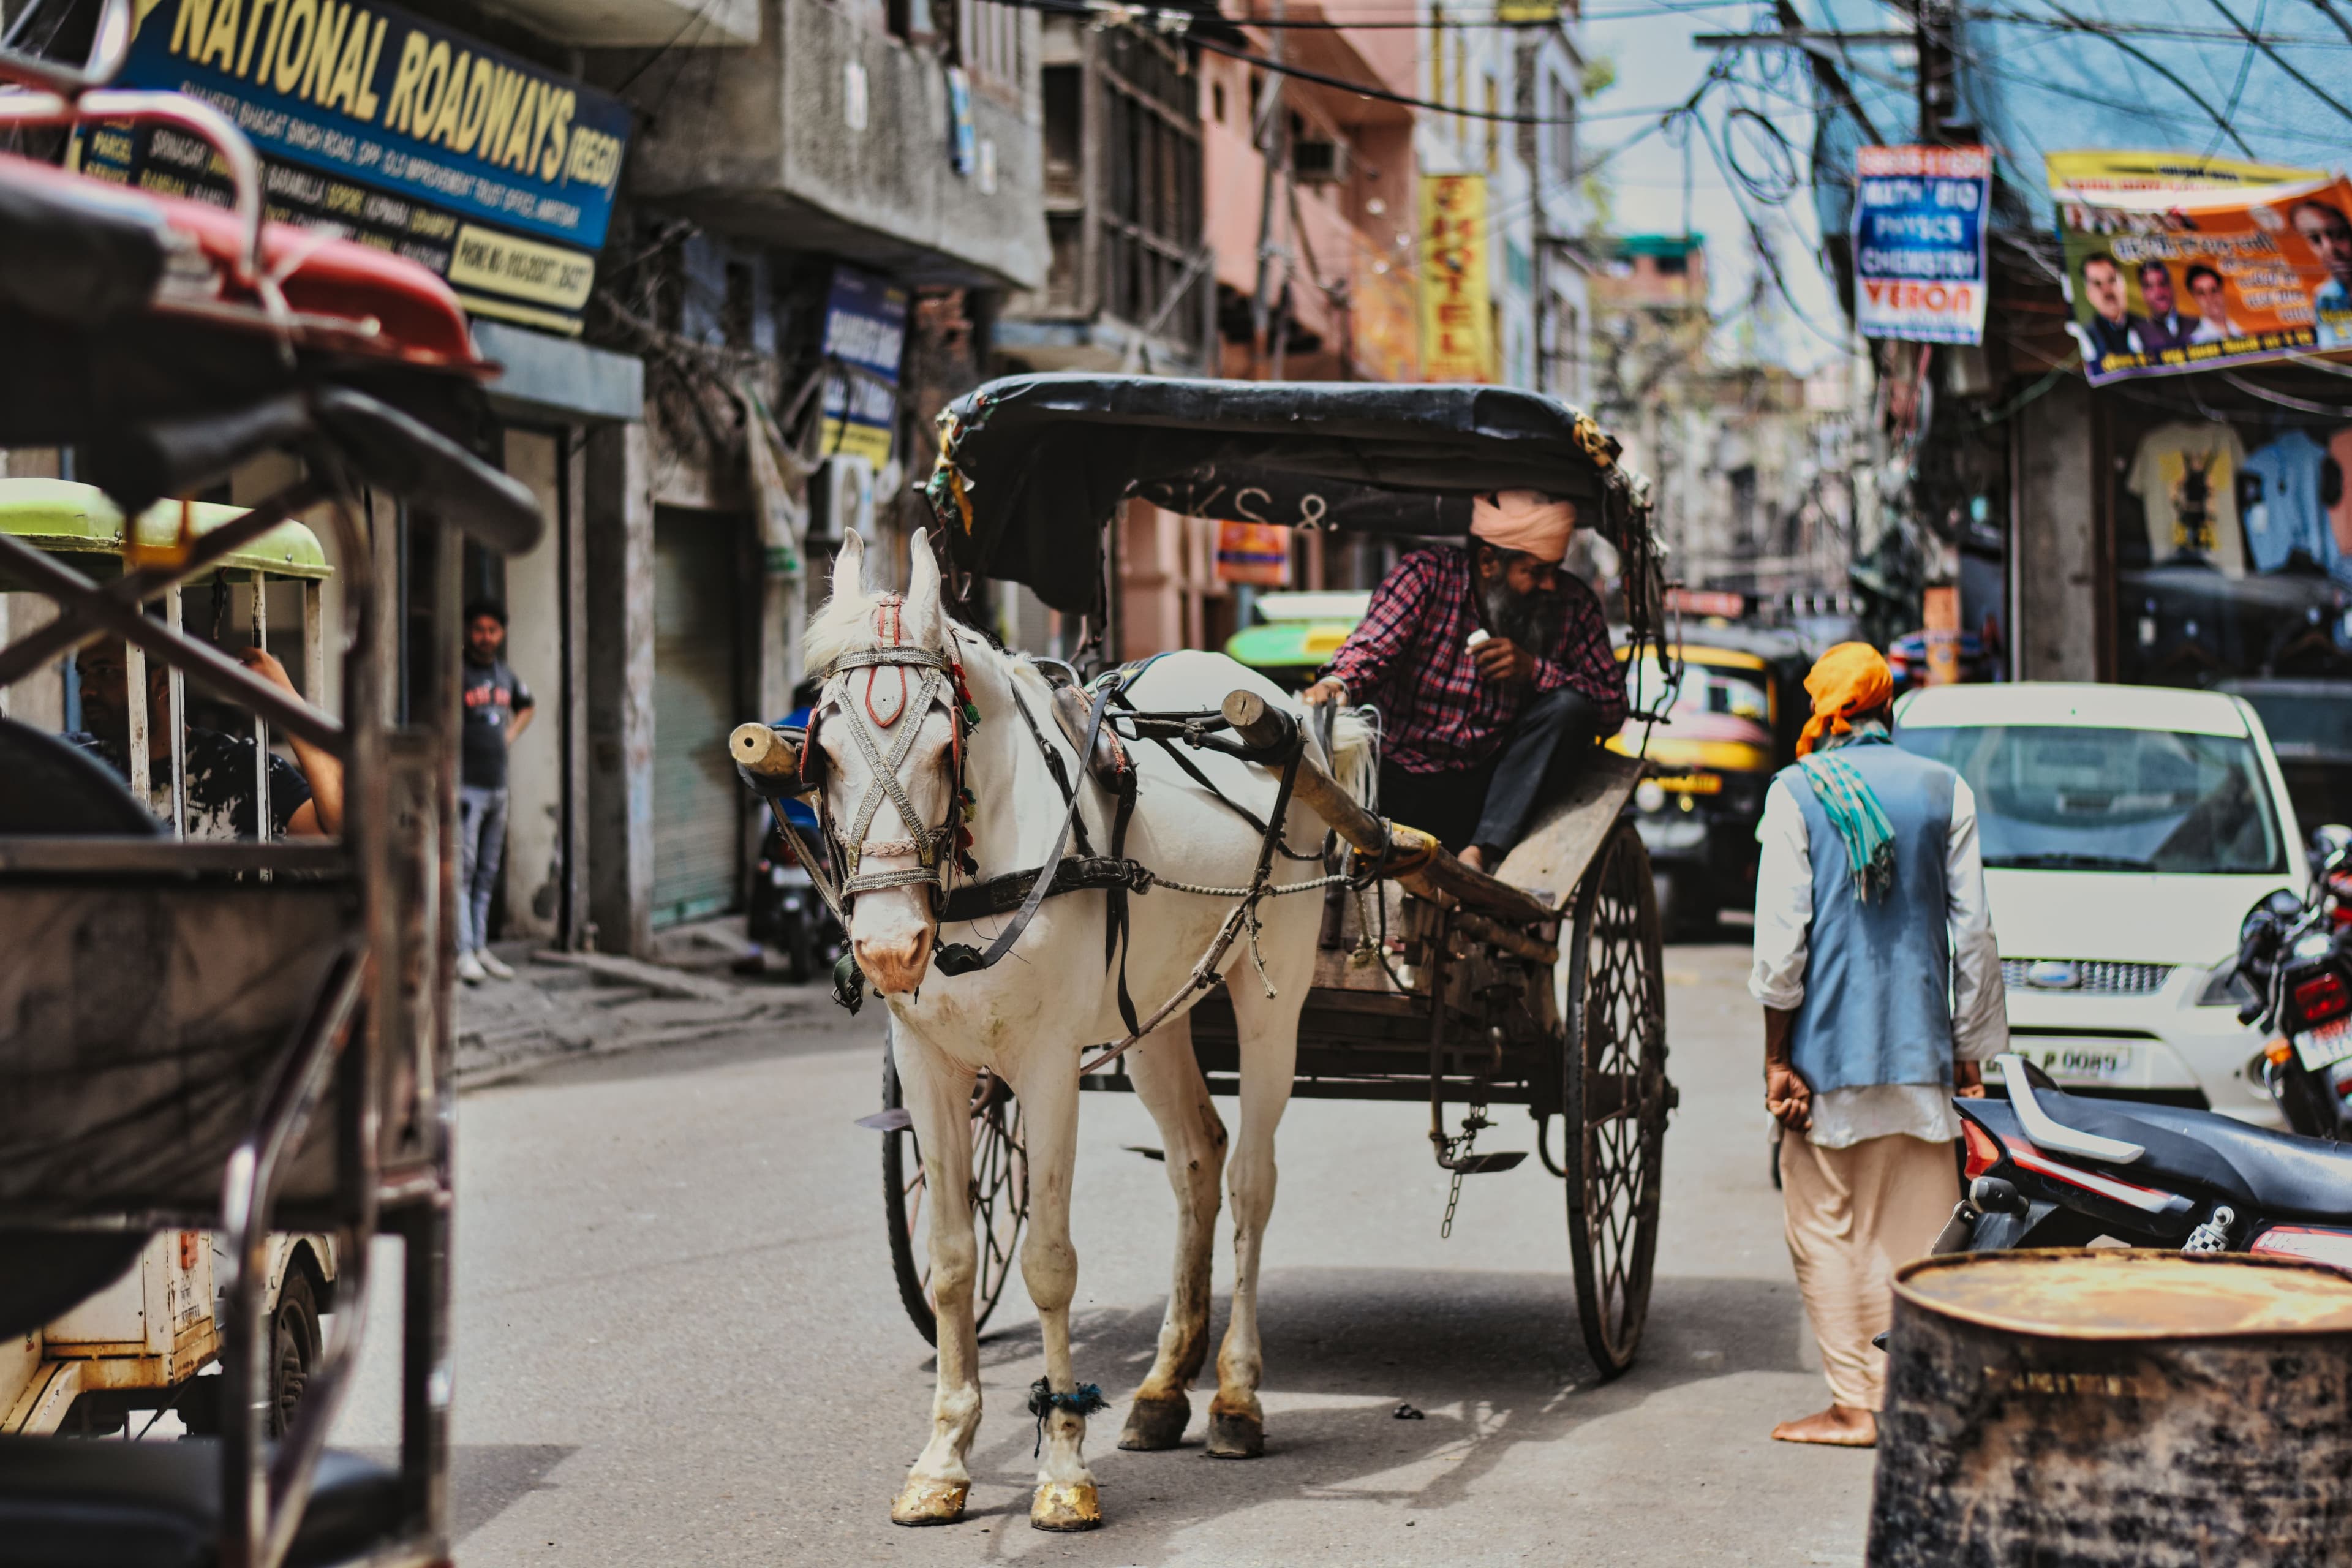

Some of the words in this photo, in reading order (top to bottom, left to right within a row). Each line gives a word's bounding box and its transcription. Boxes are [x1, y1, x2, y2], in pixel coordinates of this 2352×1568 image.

[170, 0, 388, 121] NATIONAL
[384, 29, 576, 182] ROADWAYS
[1874, 214, 1963, 243] PHYSICS
[1861, 247, 1978, 277] CHEMISTRY
